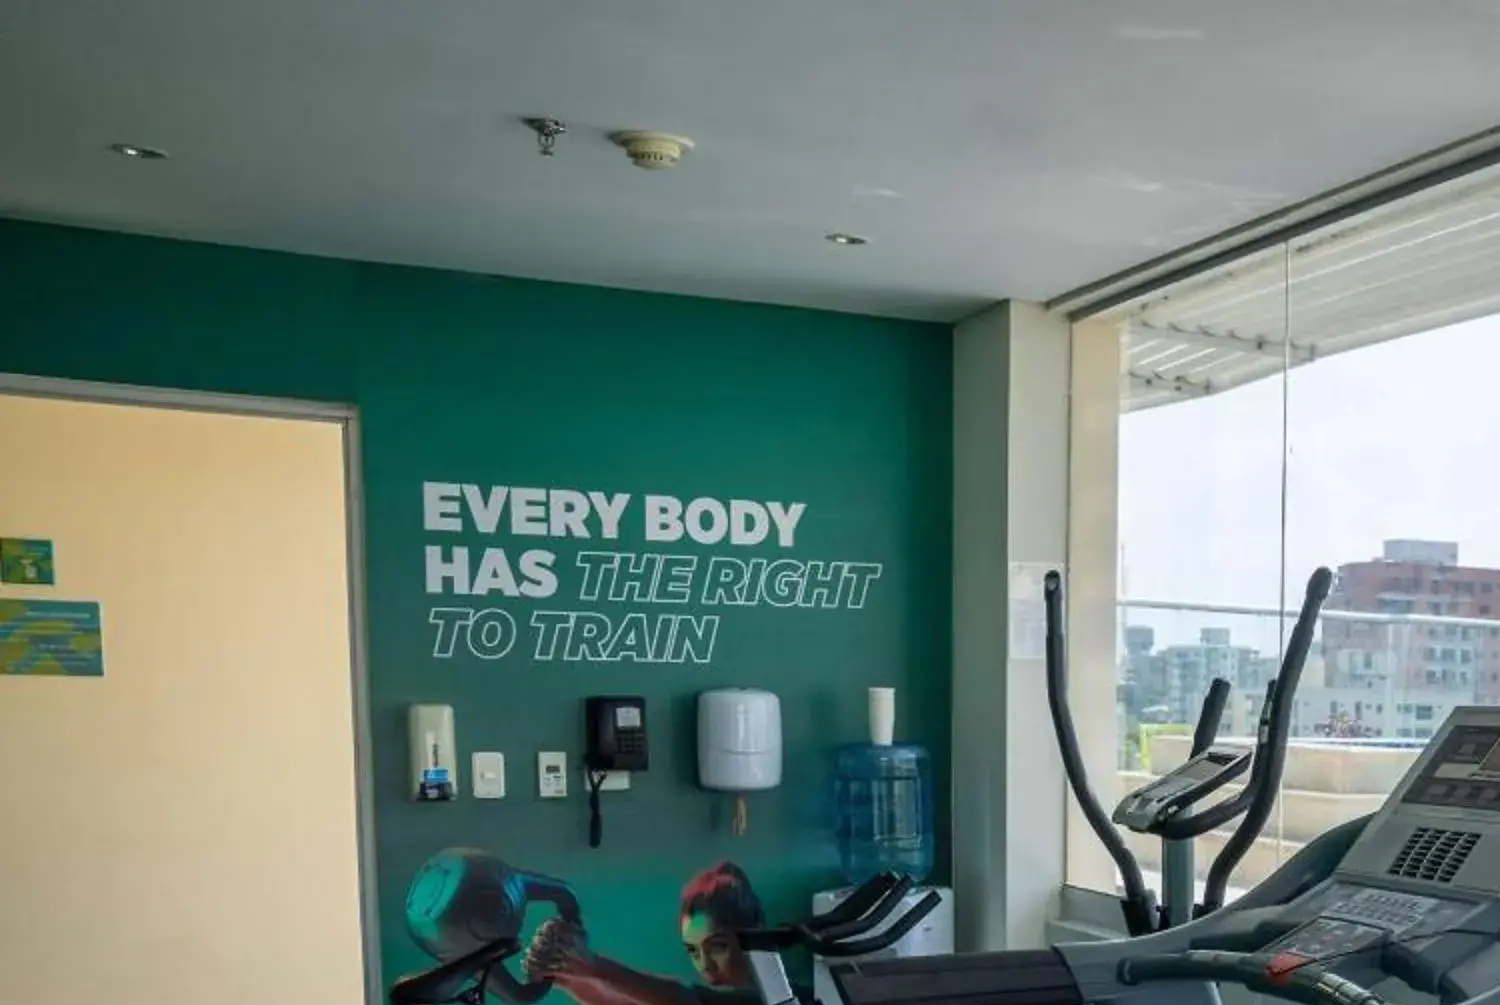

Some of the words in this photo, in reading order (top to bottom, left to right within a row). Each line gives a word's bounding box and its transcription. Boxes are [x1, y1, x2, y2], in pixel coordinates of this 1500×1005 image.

[422, 481, 631, 539] EVERY
[645, 494, 807, 548] BODY
[425, 545, 559, 598] HAS
[576, 551, 699, 604] THE
[702, 557, 883, 609] RIGHT
[429, 607, 517, 660] TO
[530, 610, 719, 663] TRAIN
